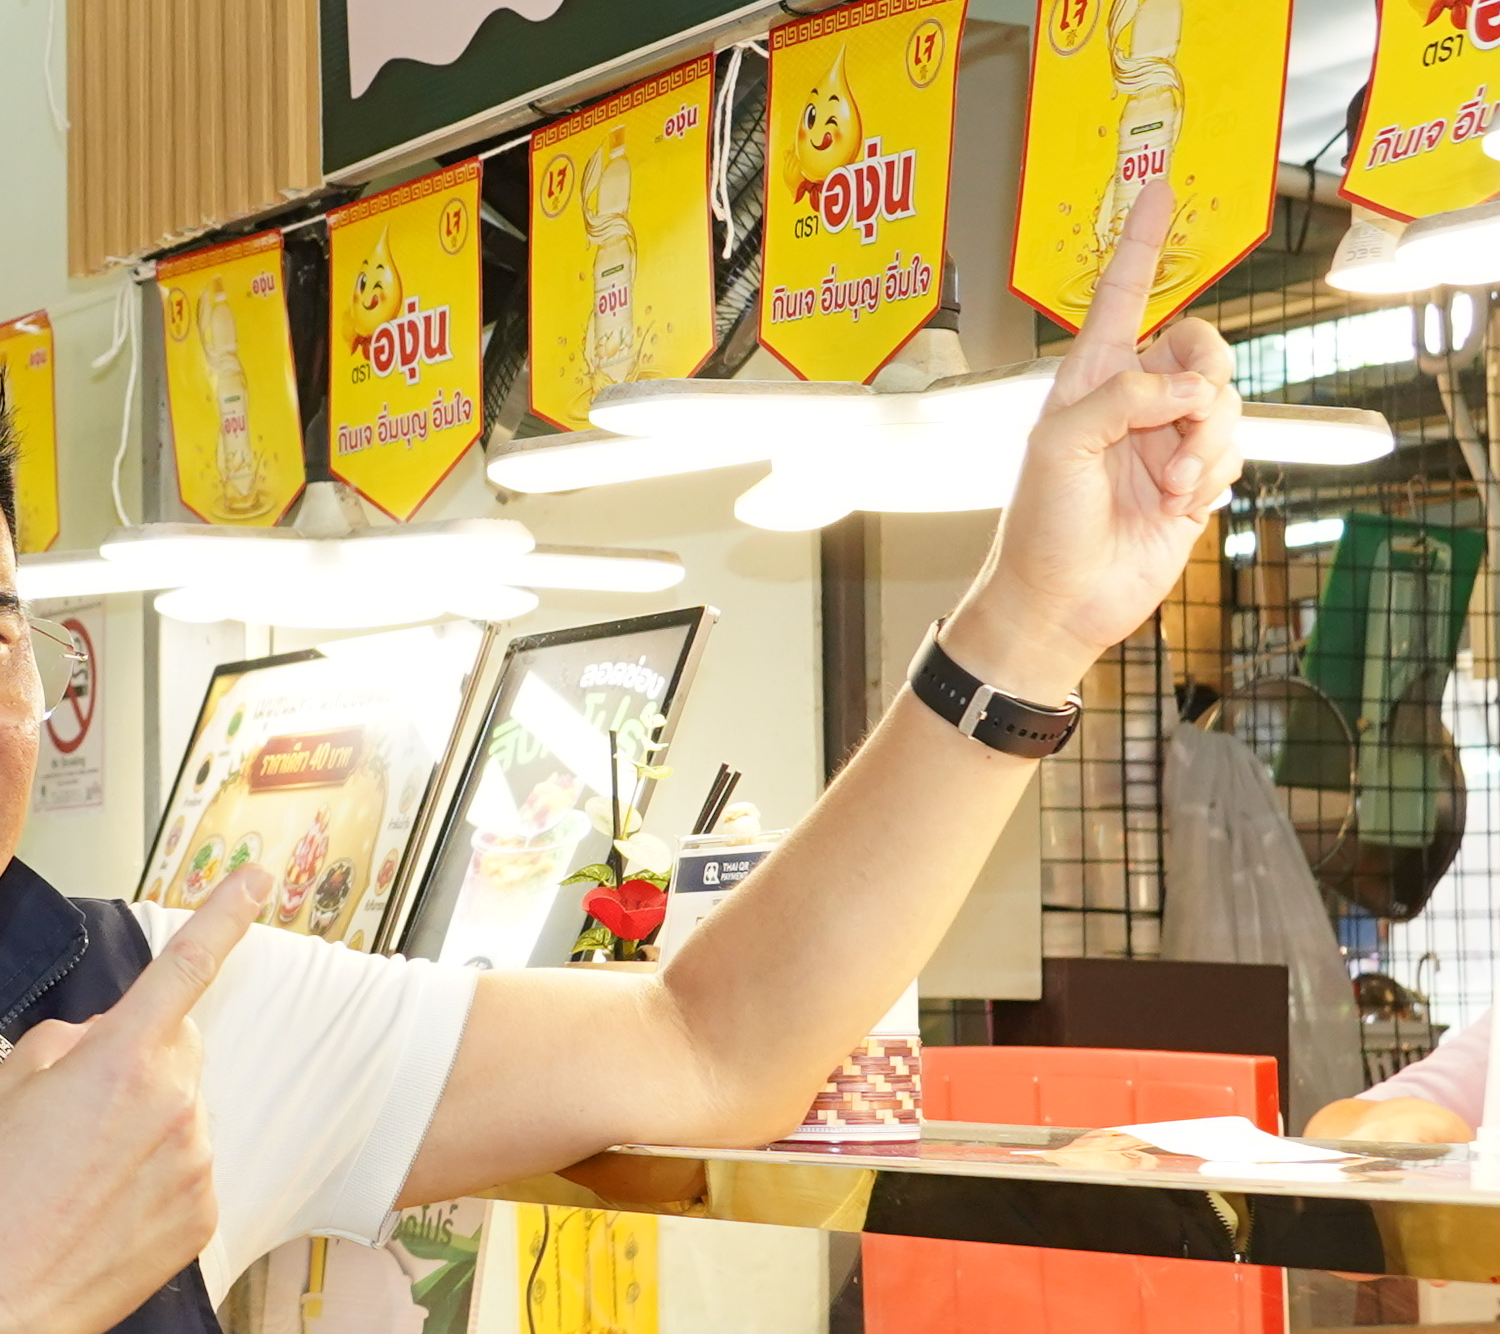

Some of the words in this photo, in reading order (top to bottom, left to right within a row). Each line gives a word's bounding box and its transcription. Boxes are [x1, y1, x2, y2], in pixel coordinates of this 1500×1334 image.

[912, 34, 940, 67] เจ
[1422, 33, 1465, 68] ตรา
[664, 103, 700, 140] องุ่น
[1365, 115, 1447, 171] กินเจ
[547, 163, 568, 199] เจ
[1122, 141, 1168, 188] องุ่น
[793, 212, 820, 242] ตรา
[821, 138, 916, 244] องุ่น
[445, 209, 462, 235] เจ
[251, 271, 277, 301] องุ่น
[597, 283, 630, 318] องุ่น
[770, 286, 816, 324] กินเจ
[818, 271, 881, 323] อิ่มบุญ
[885, 260, 932, 300] อิ่มใจ
[351, 362, 371, 385] ตรา
[371, 298, 452, 384] องุ่น
[222, 409, 247, 439] องุ่น
[337, 422, 373, 455] กินเจ
[377, 402, 428, 451] อิ่มบุญ
[432, 389, 475, 431] อิ่มใจ
[579, 654, 667, 700] ลอดช่อง
[310, 741, 333, 771] 40
